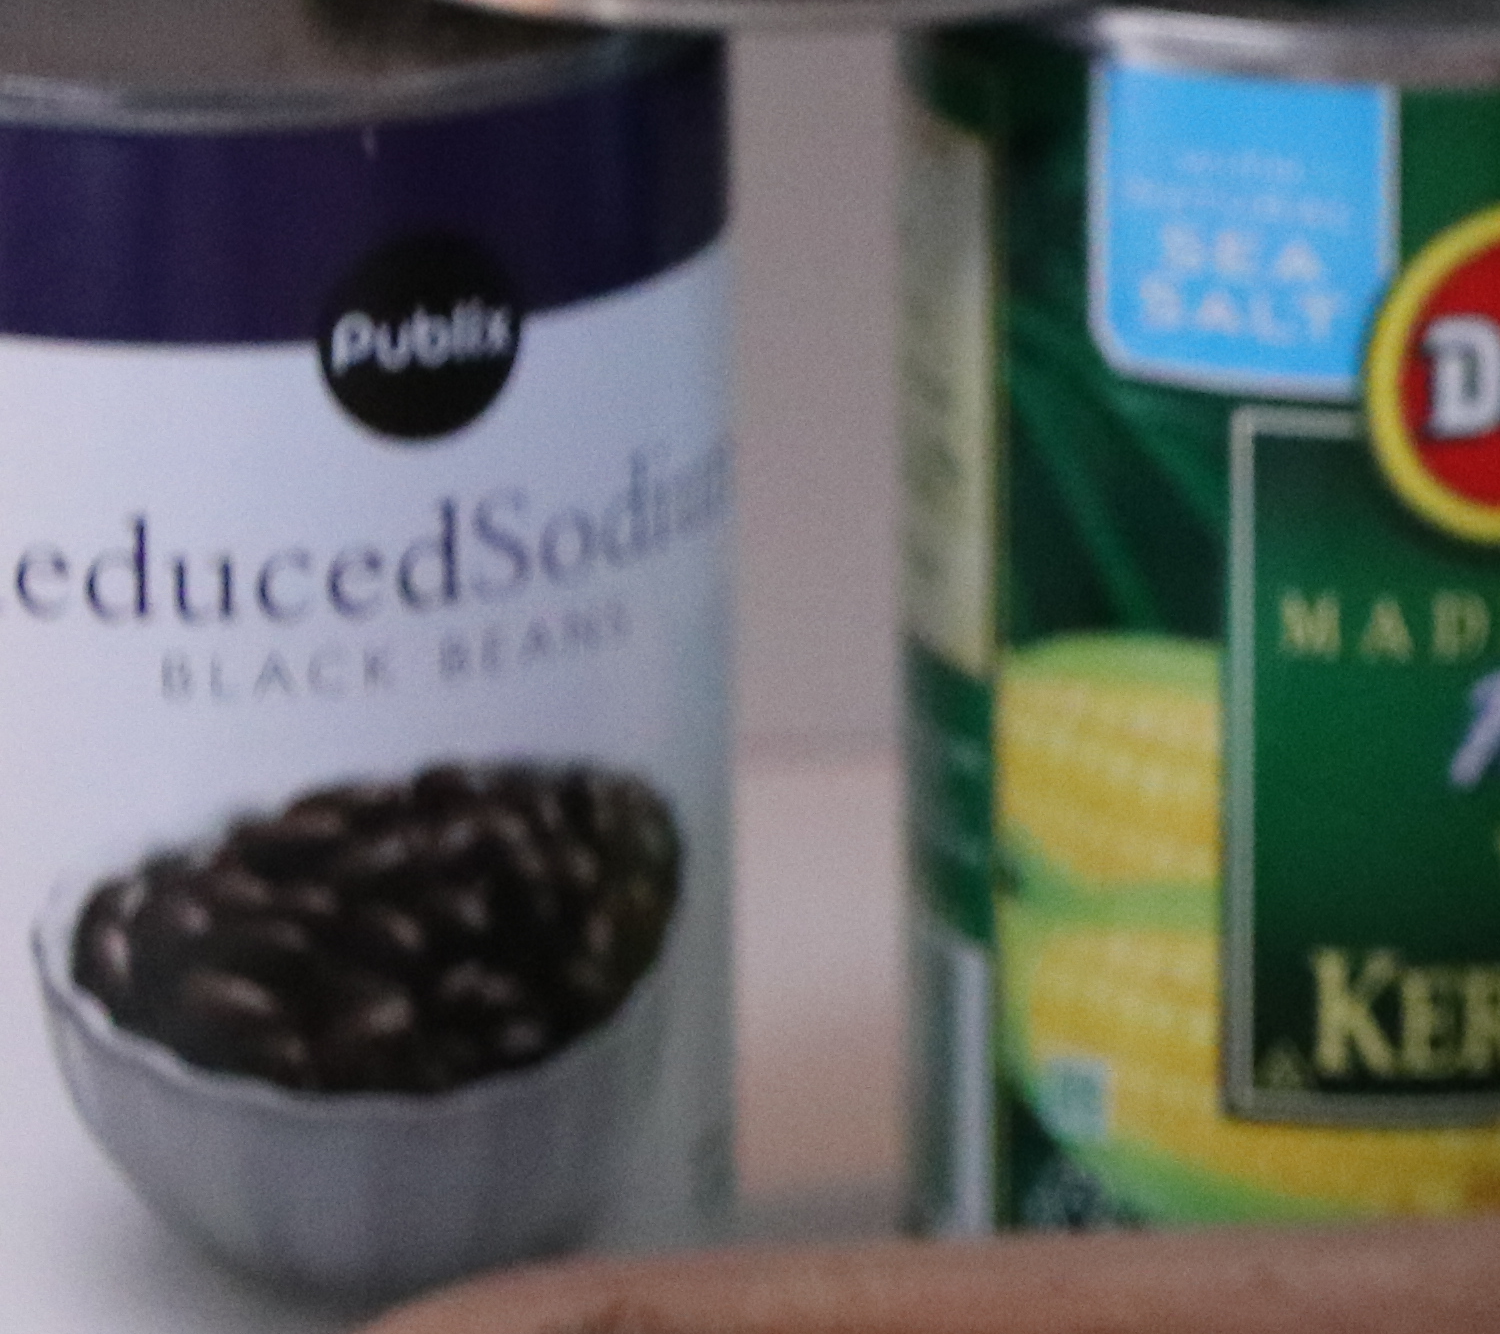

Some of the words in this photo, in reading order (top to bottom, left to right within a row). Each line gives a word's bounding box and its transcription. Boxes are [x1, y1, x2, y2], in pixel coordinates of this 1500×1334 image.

[1160, 223, 1326, 282] SEA
[1138, 270, 1345, 350] SALT
[160, 647, 396, 703] BLACK
[438, 597, 633, 685] BEANS
